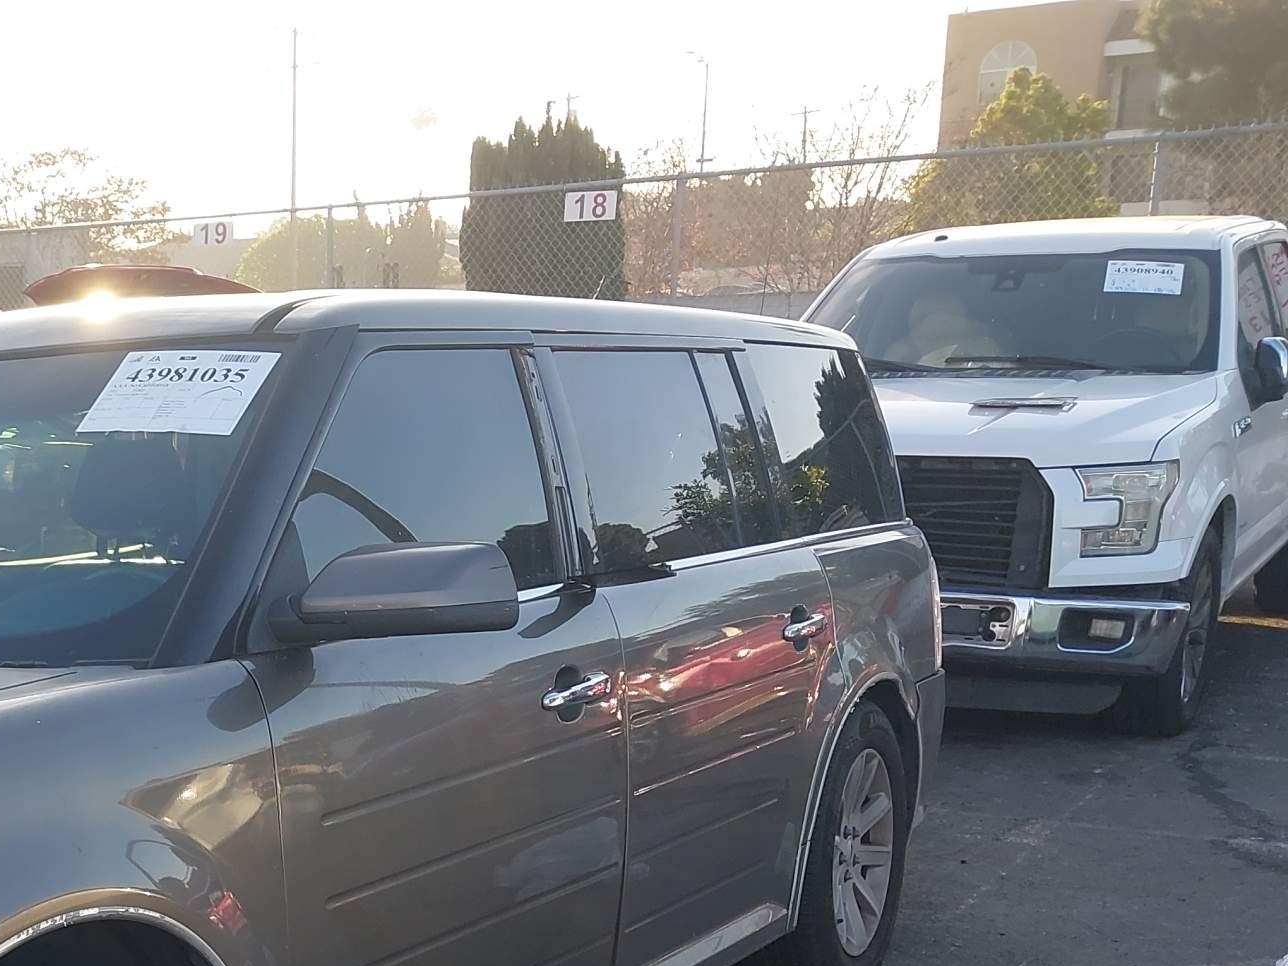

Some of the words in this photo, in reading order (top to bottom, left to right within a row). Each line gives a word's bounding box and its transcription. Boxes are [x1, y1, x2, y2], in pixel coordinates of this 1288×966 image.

[574, 193, 607, 219] 18
[200, 222, 227, 245] 19
[125, 367, 249, 383] 43981035
